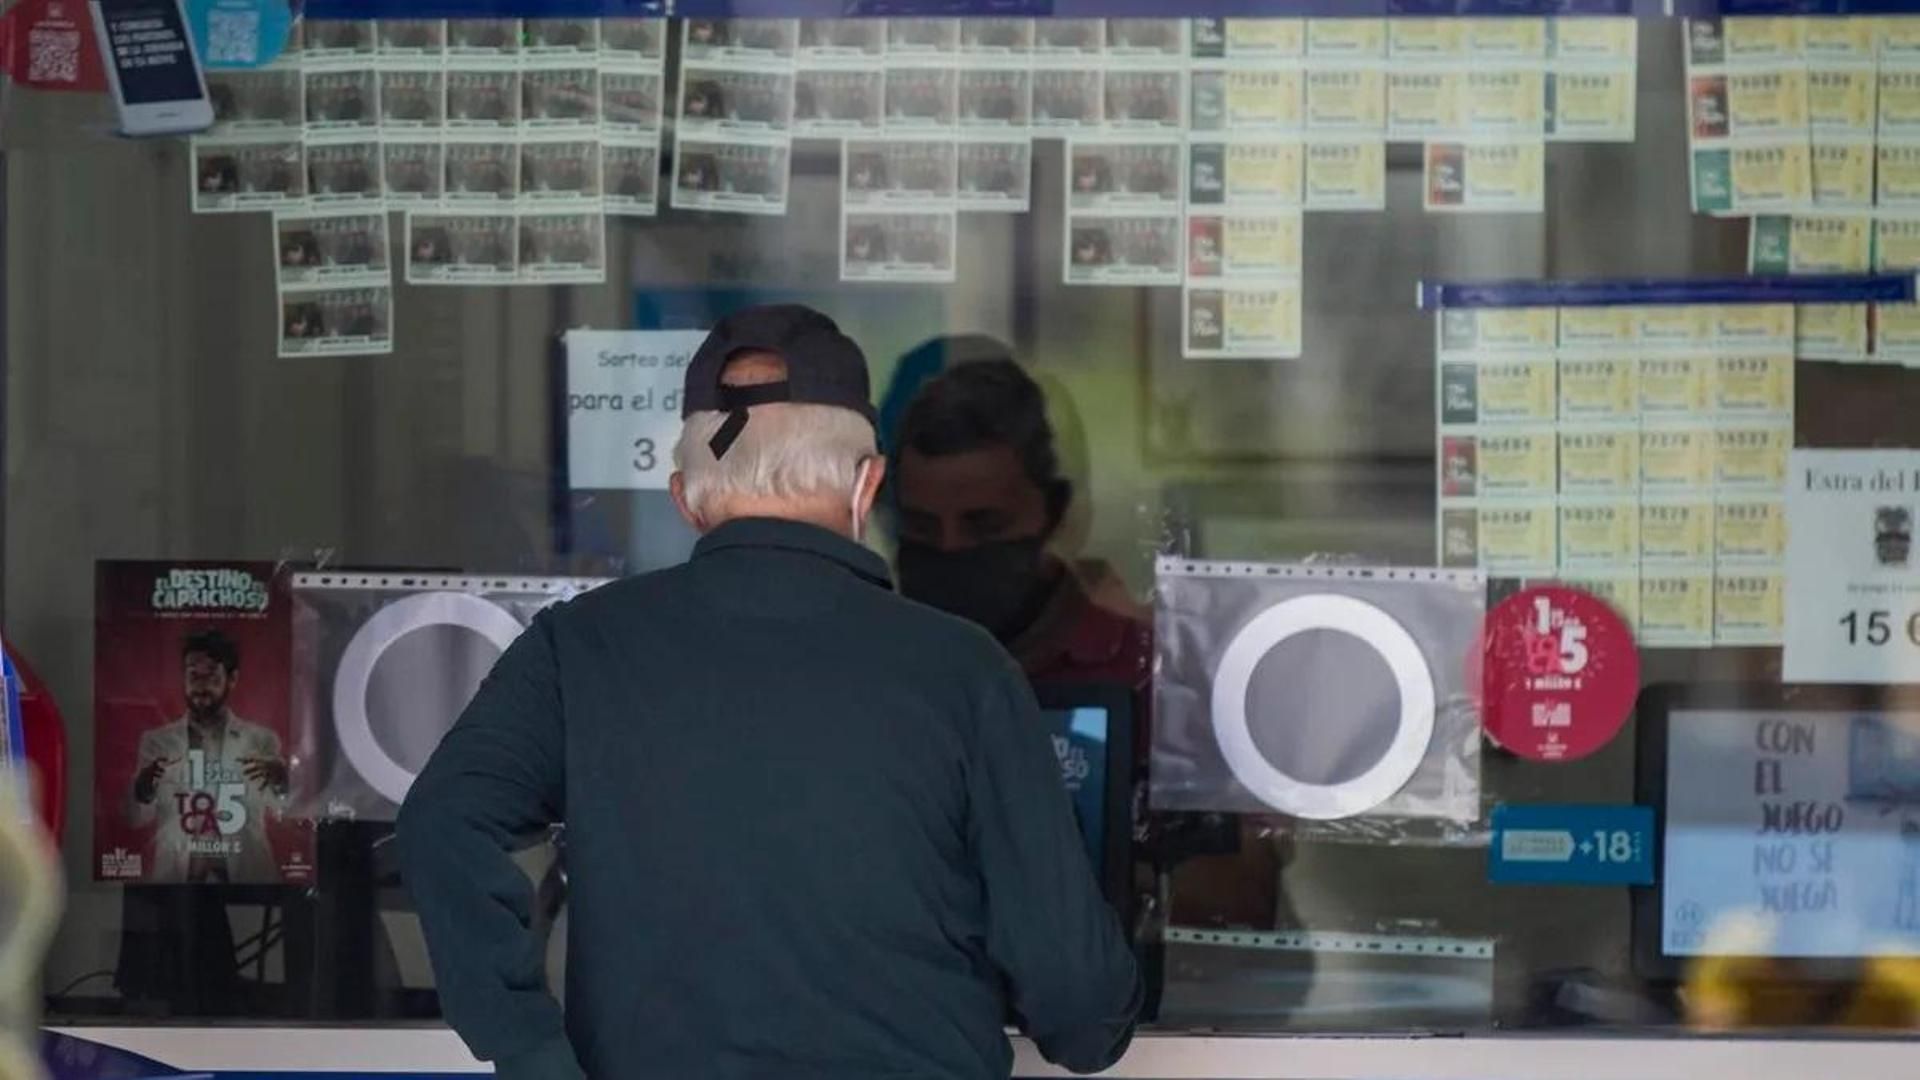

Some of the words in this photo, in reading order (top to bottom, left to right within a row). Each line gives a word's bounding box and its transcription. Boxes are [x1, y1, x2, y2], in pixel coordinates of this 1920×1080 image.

[598, 351, 658, 368] Sorteo
[570, 392, 623, 416] para
[631, 388, 653, 411] el
[633, 437, 657, 472] 3
[1805, 468, 1863, 492] Extra
[1870, 468, 1905, 492] del
[170, 568, 251, 590] DESTINO
[151, 588, 269, 611] CAPRICHOSO
[1534, 596, 1551, 634] 1
[1839, 610, 1891, 646] 15
[1559, 624, 1589, 675] 5
[1756, 719, 1816, 755] CON
[188, 749, 205, 790] 1
[1754, 759, 1784, 796] EL
[218, 784, 246, 834] 5
[1759, 802, 1844, 836] JUEGO
[1578, 830, 1633, 863] +18
[1753, 843, 1797, 877] NO
